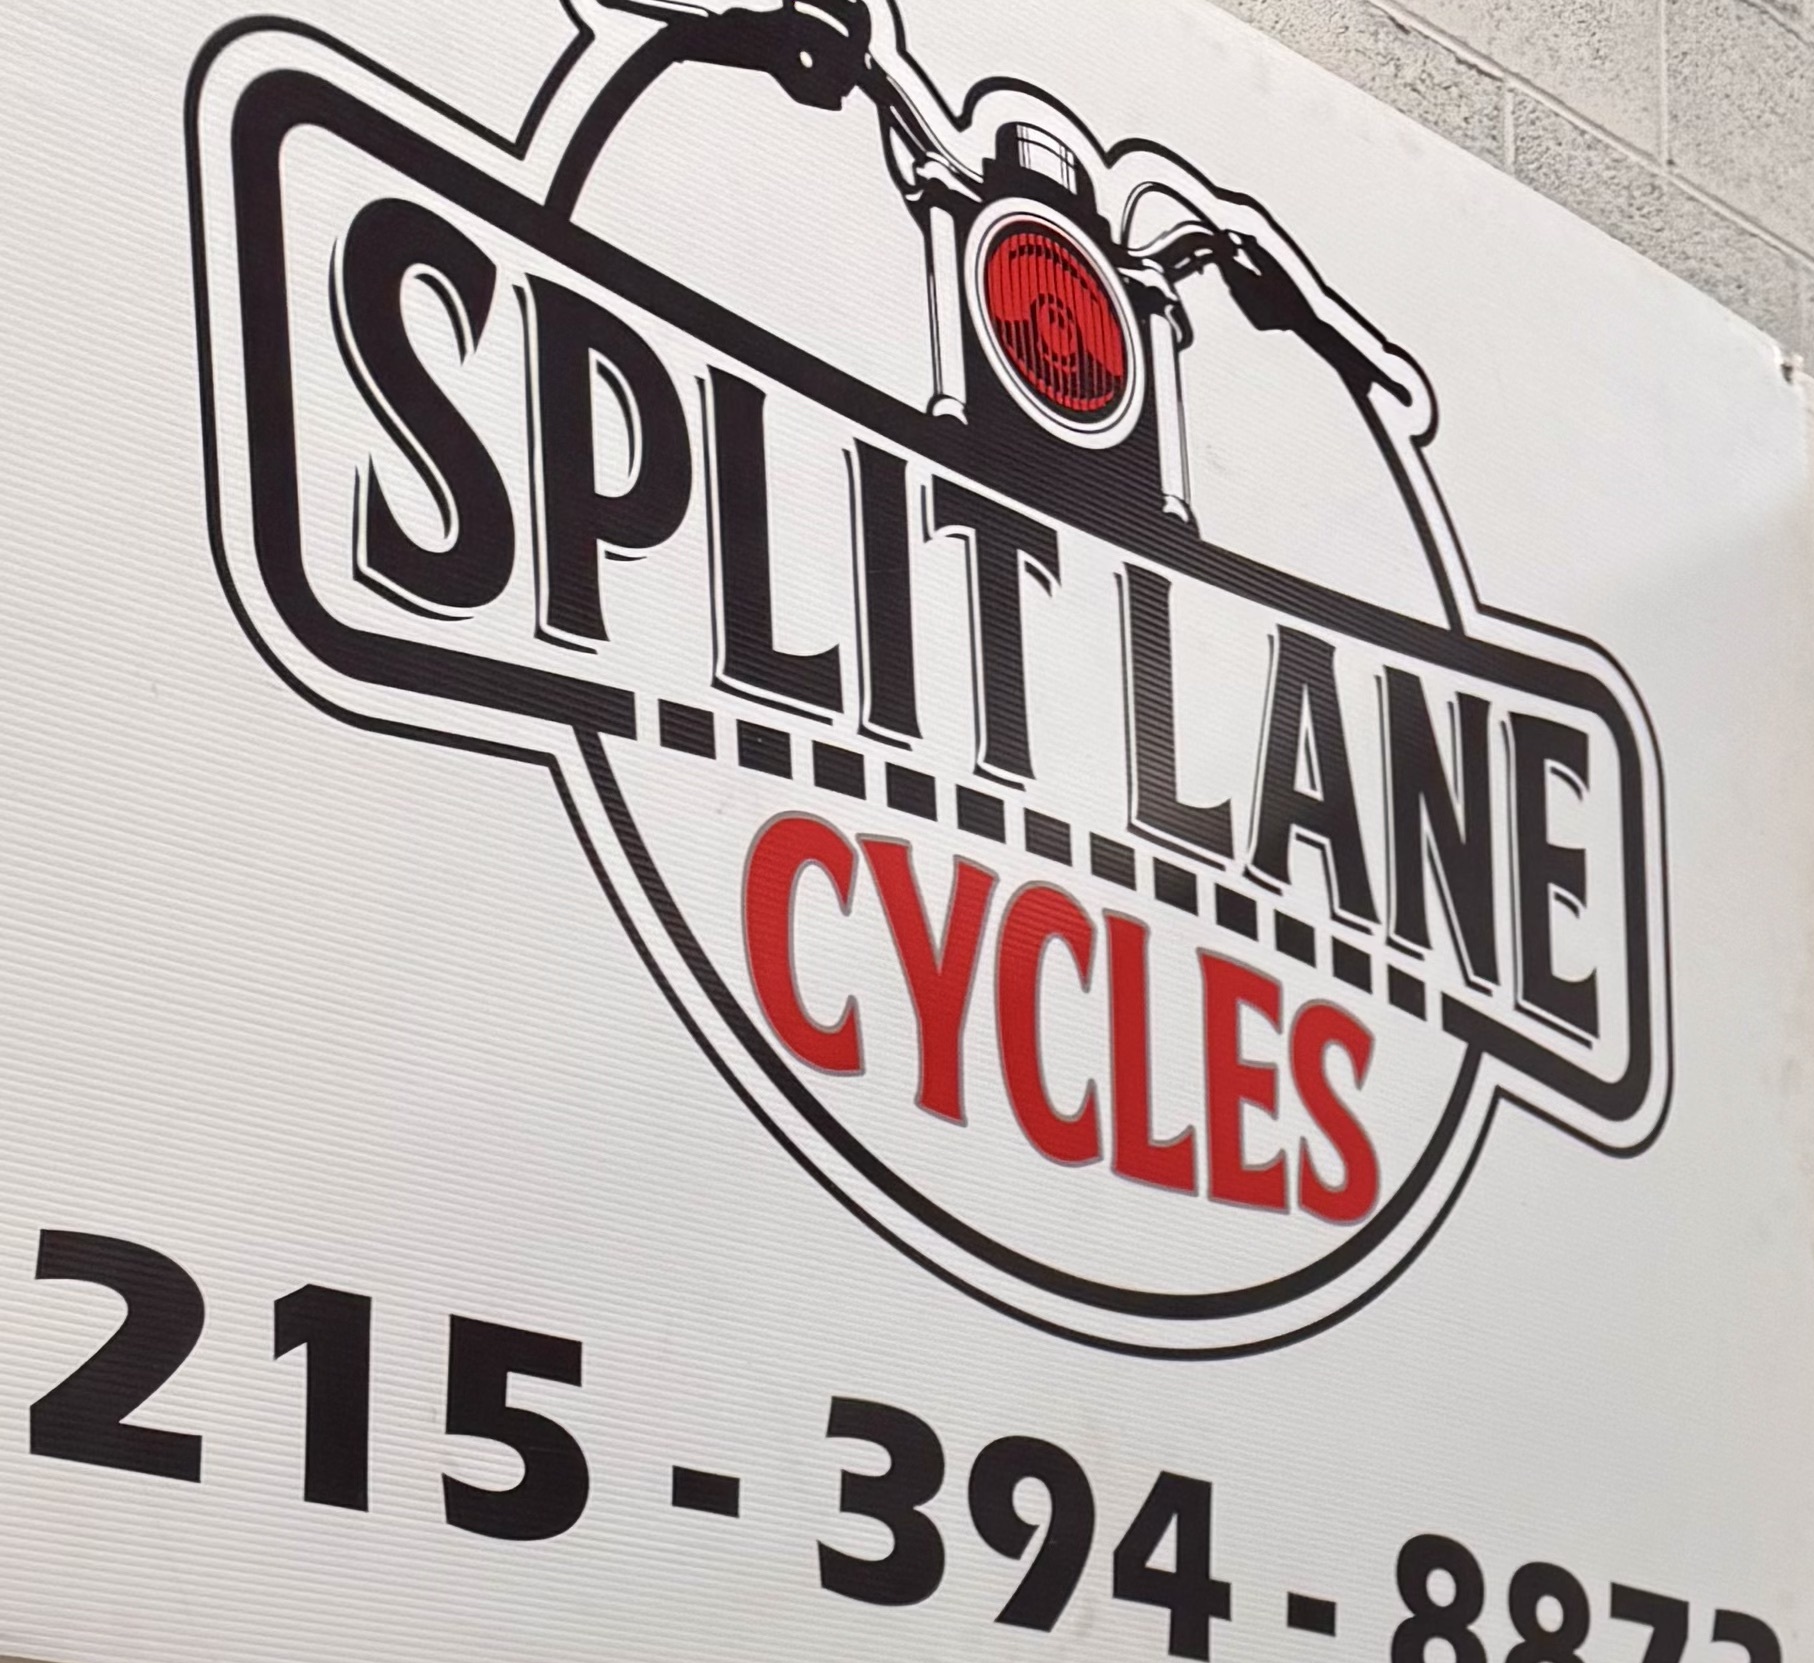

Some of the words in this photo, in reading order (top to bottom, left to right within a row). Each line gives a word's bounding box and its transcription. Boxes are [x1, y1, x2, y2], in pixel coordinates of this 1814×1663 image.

[329, 198, 1061, 788] SPLIT
[1116, 562, 1600, 1050] LANE
[743, 814, 1380, 1224] CYCLES
